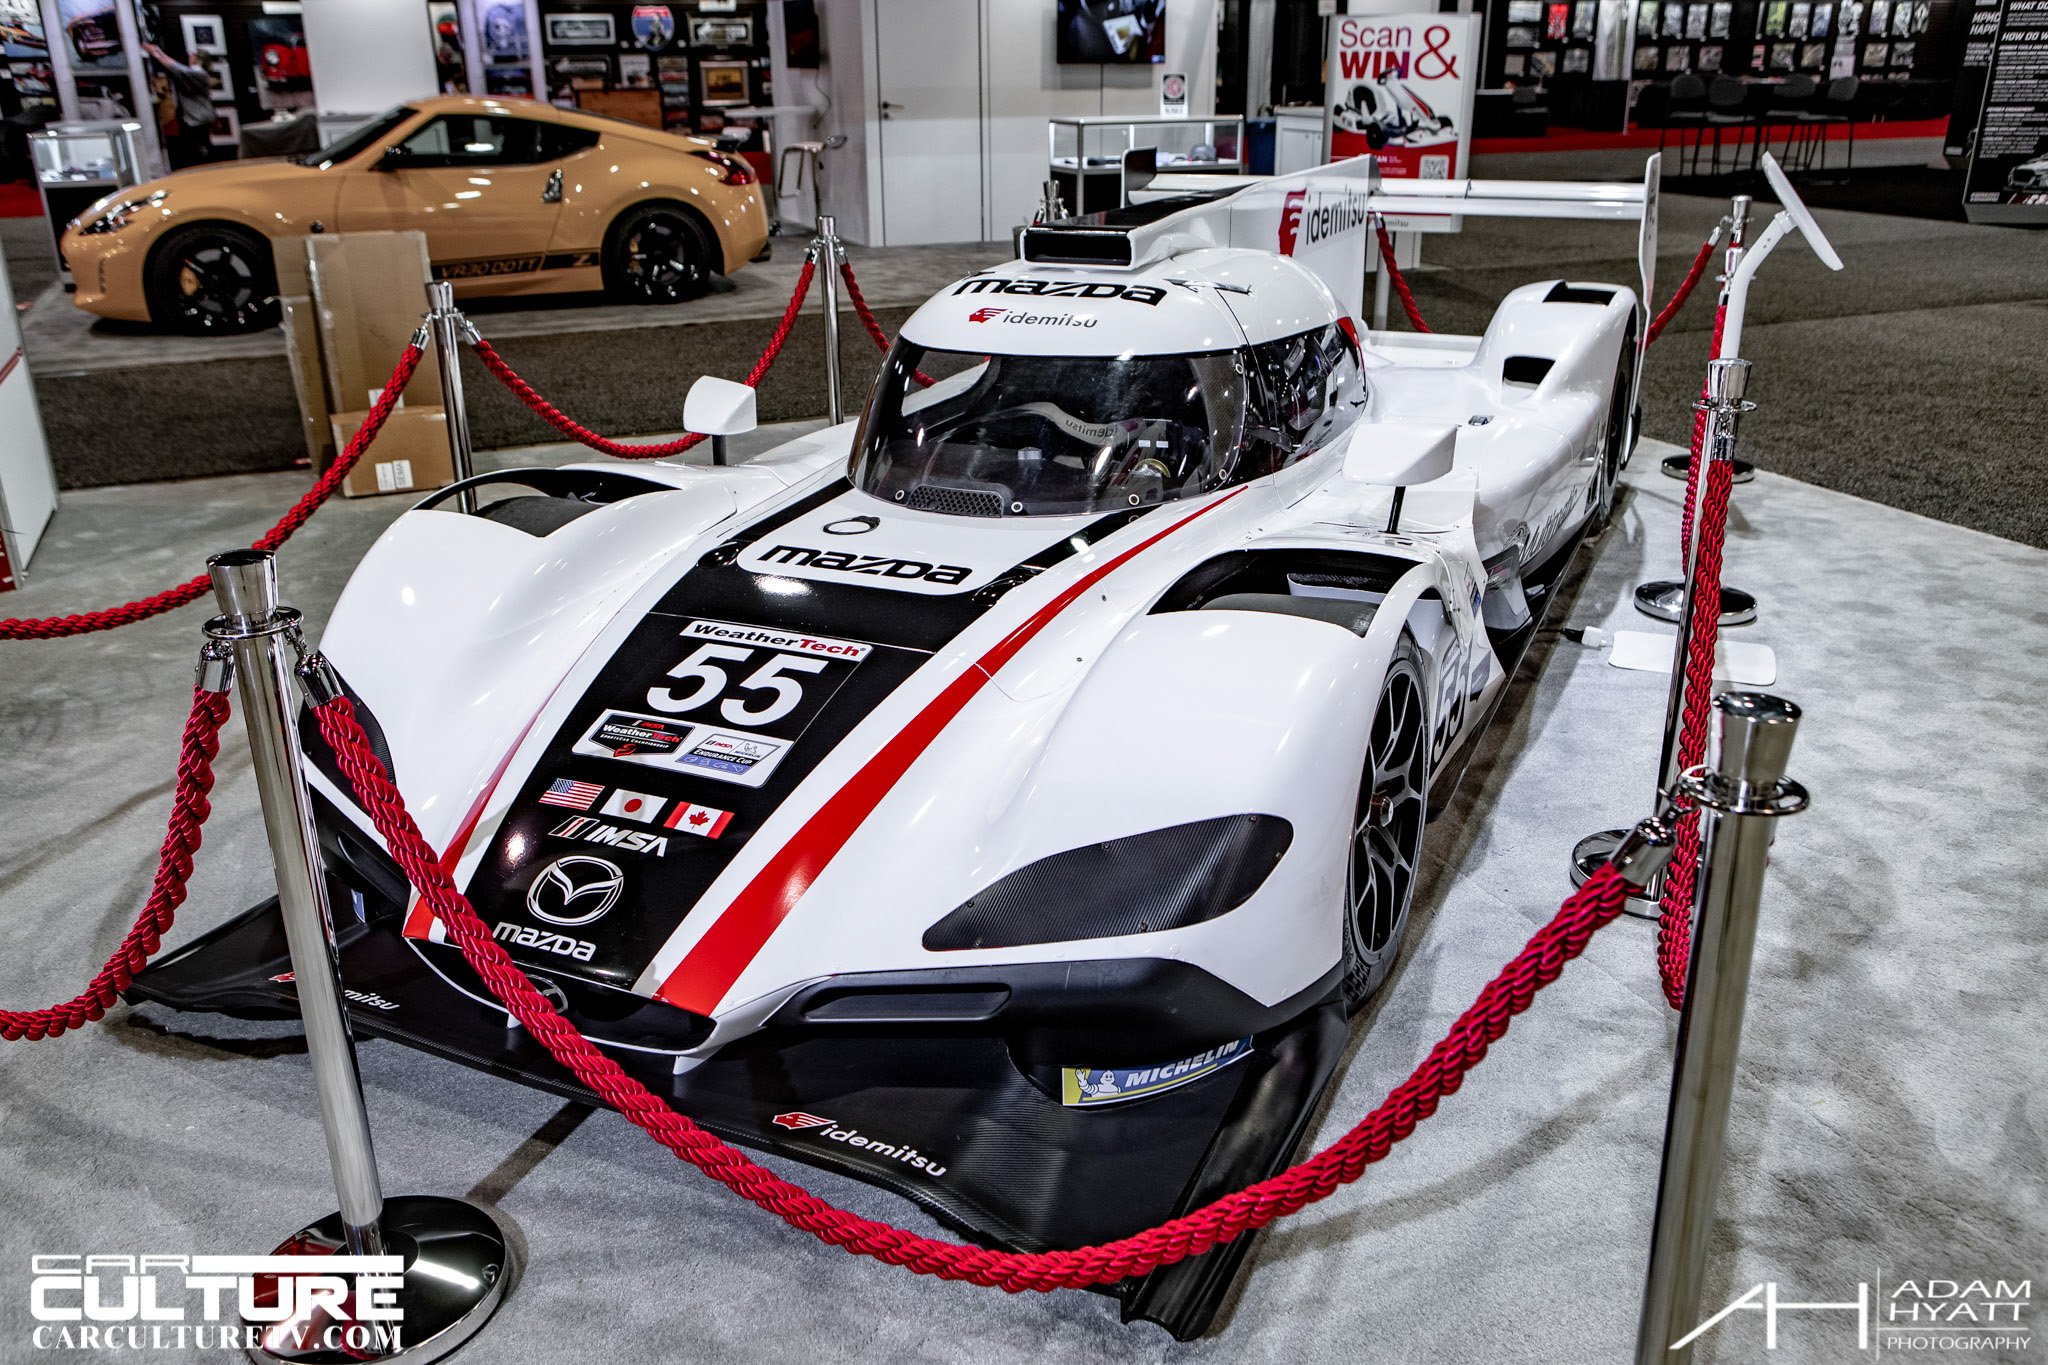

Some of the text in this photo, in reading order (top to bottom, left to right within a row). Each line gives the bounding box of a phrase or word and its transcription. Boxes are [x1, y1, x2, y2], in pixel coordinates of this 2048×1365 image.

[2009, 1, 2037, 11] WHAT
[1340, 19, 1460, 80] Scan &
[2001, 32, 2025, 41] HOW
[2024, 32, 2040, 41] DO
[1340, 51, 1410, 80] WIN
[1305, 184, 1366, 246] idemitsu
[1003, 310, 1098, 329] idemitsu
[646, 643, 828, 727] 55
[584, 824, 669, 857] IMSA
[344, 989, 400, 1010] mitsu
[1124, 1040, 1240, 1089] MICHELIN
[820, 1122, 947, 1178] idemitsu
